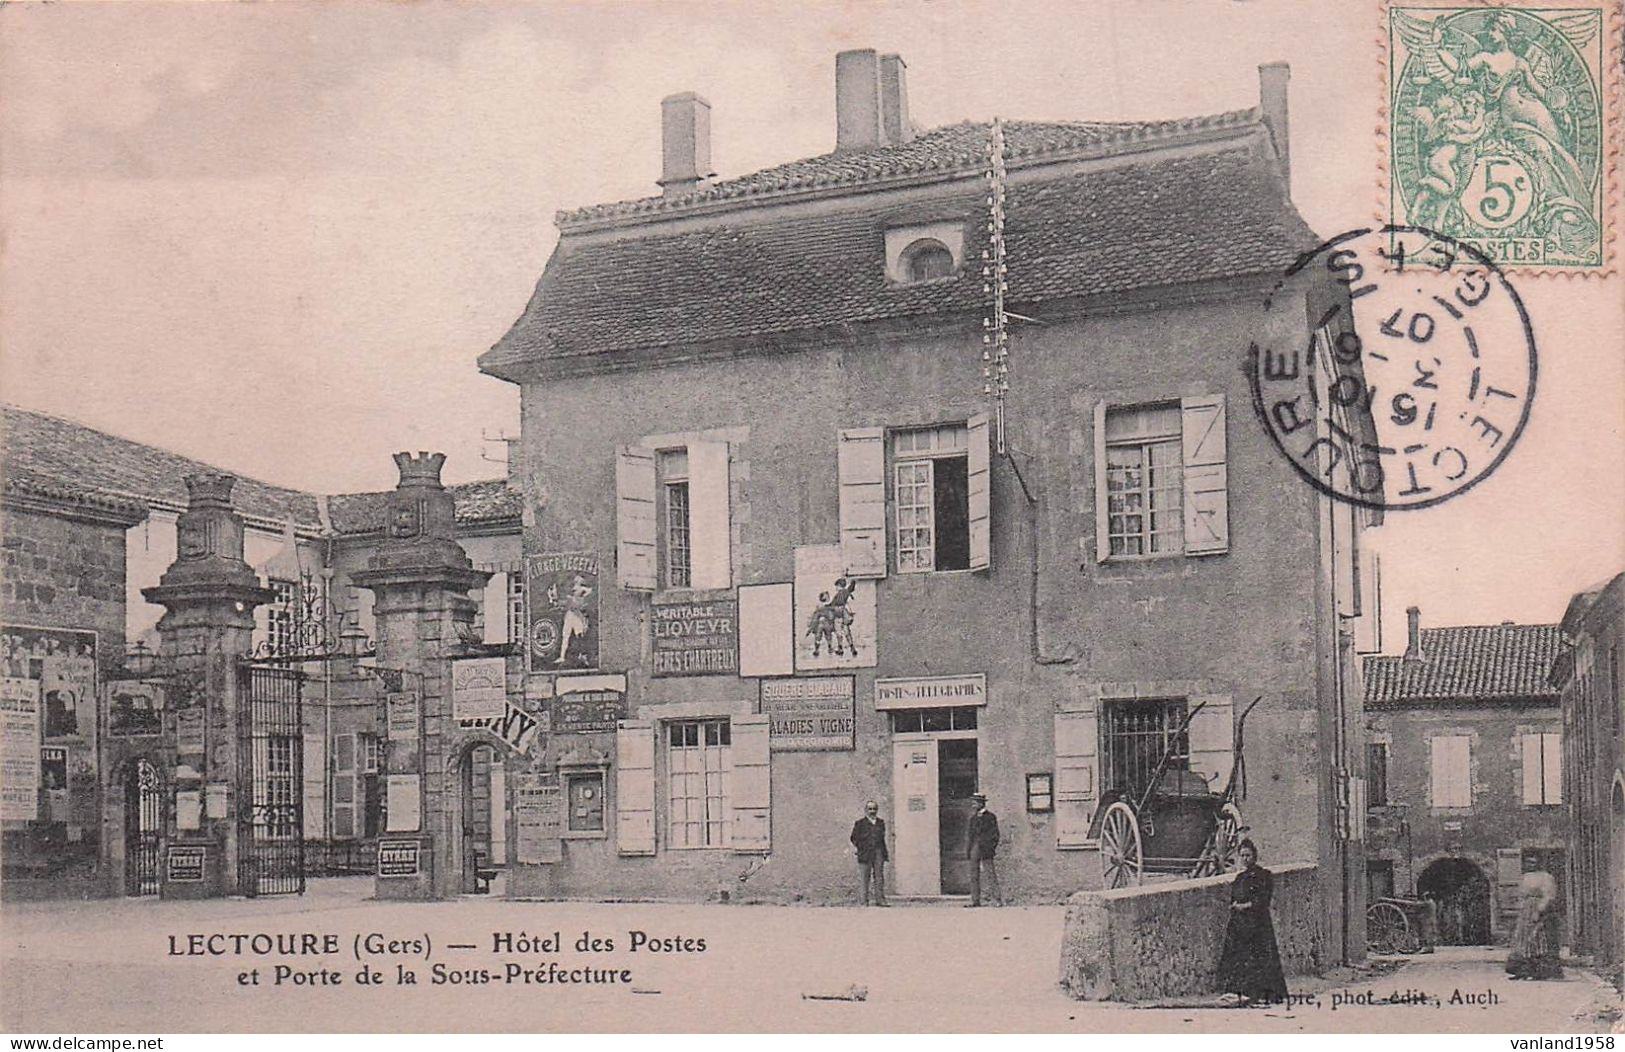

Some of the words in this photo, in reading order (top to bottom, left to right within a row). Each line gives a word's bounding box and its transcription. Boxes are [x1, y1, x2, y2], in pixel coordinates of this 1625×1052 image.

[1454, 238, 1540, 262] POSTES
[1264, 349, 1517, 496] LECTOURE
[769, 719, 814, 736] ALADIES
[819, 718, 853, 734] VIGNE
